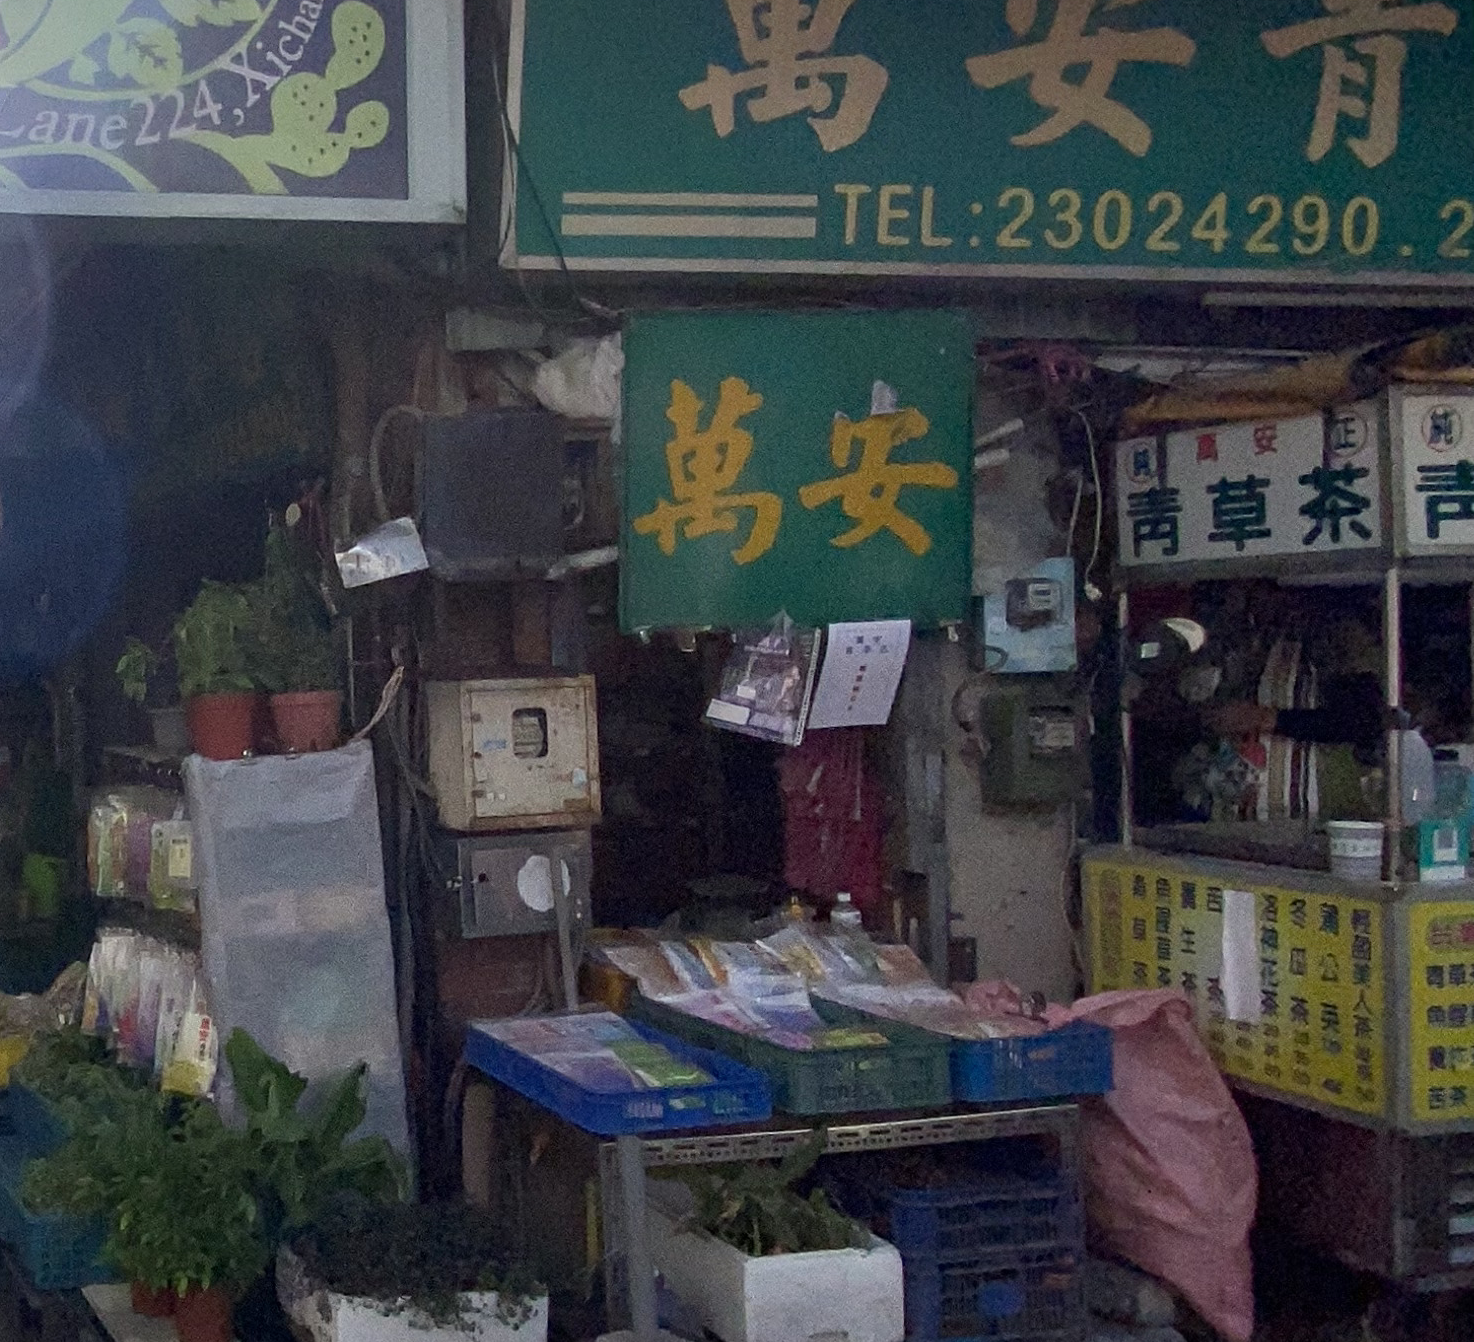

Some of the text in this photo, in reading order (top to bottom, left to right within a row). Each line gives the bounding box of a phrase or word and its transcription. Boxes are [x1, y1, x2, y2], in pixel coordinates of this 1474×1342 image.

[633, 376, 959, 565] 萬安
[1127, 461, 1374, 558] 青草茶
